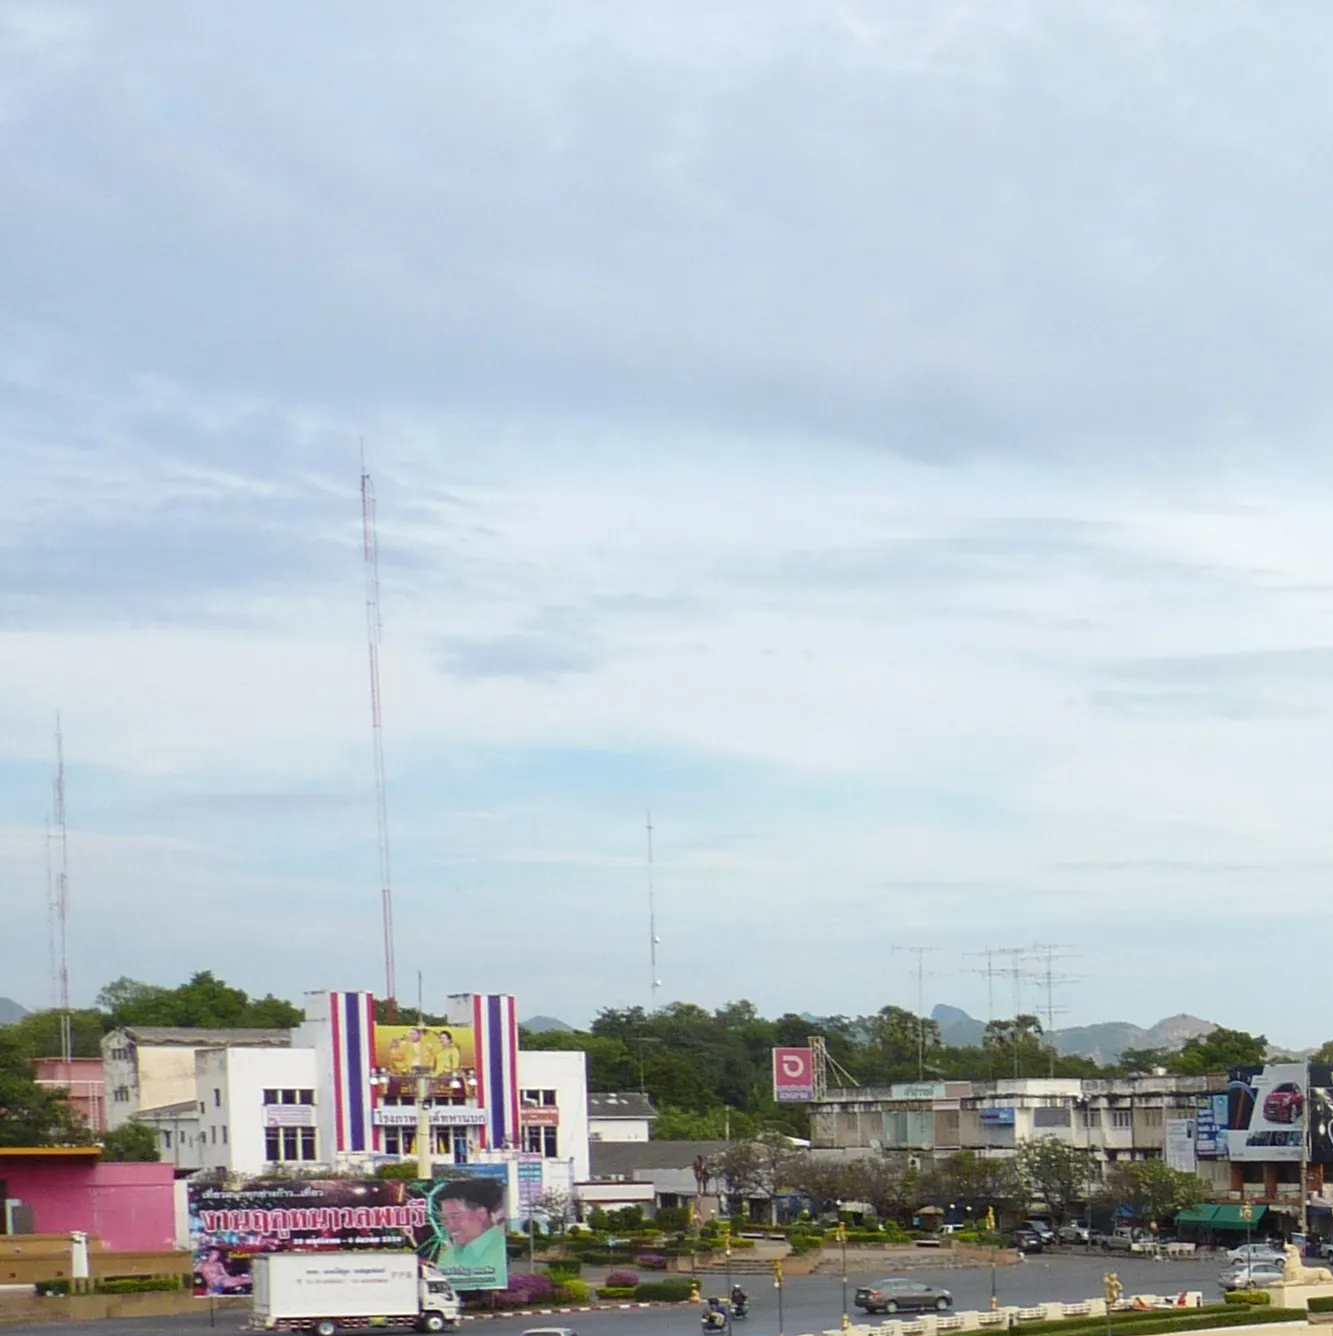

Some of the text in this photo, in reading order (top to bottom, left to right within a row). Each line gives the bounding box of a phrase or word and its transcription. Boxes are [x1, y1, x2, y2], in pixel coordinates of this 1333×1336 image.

[377, 1110, 485, 1124] โรงภาพต์ทหารบก
[200, 1198, 428, 1239] งานฤดูหนาวลพบุรี
